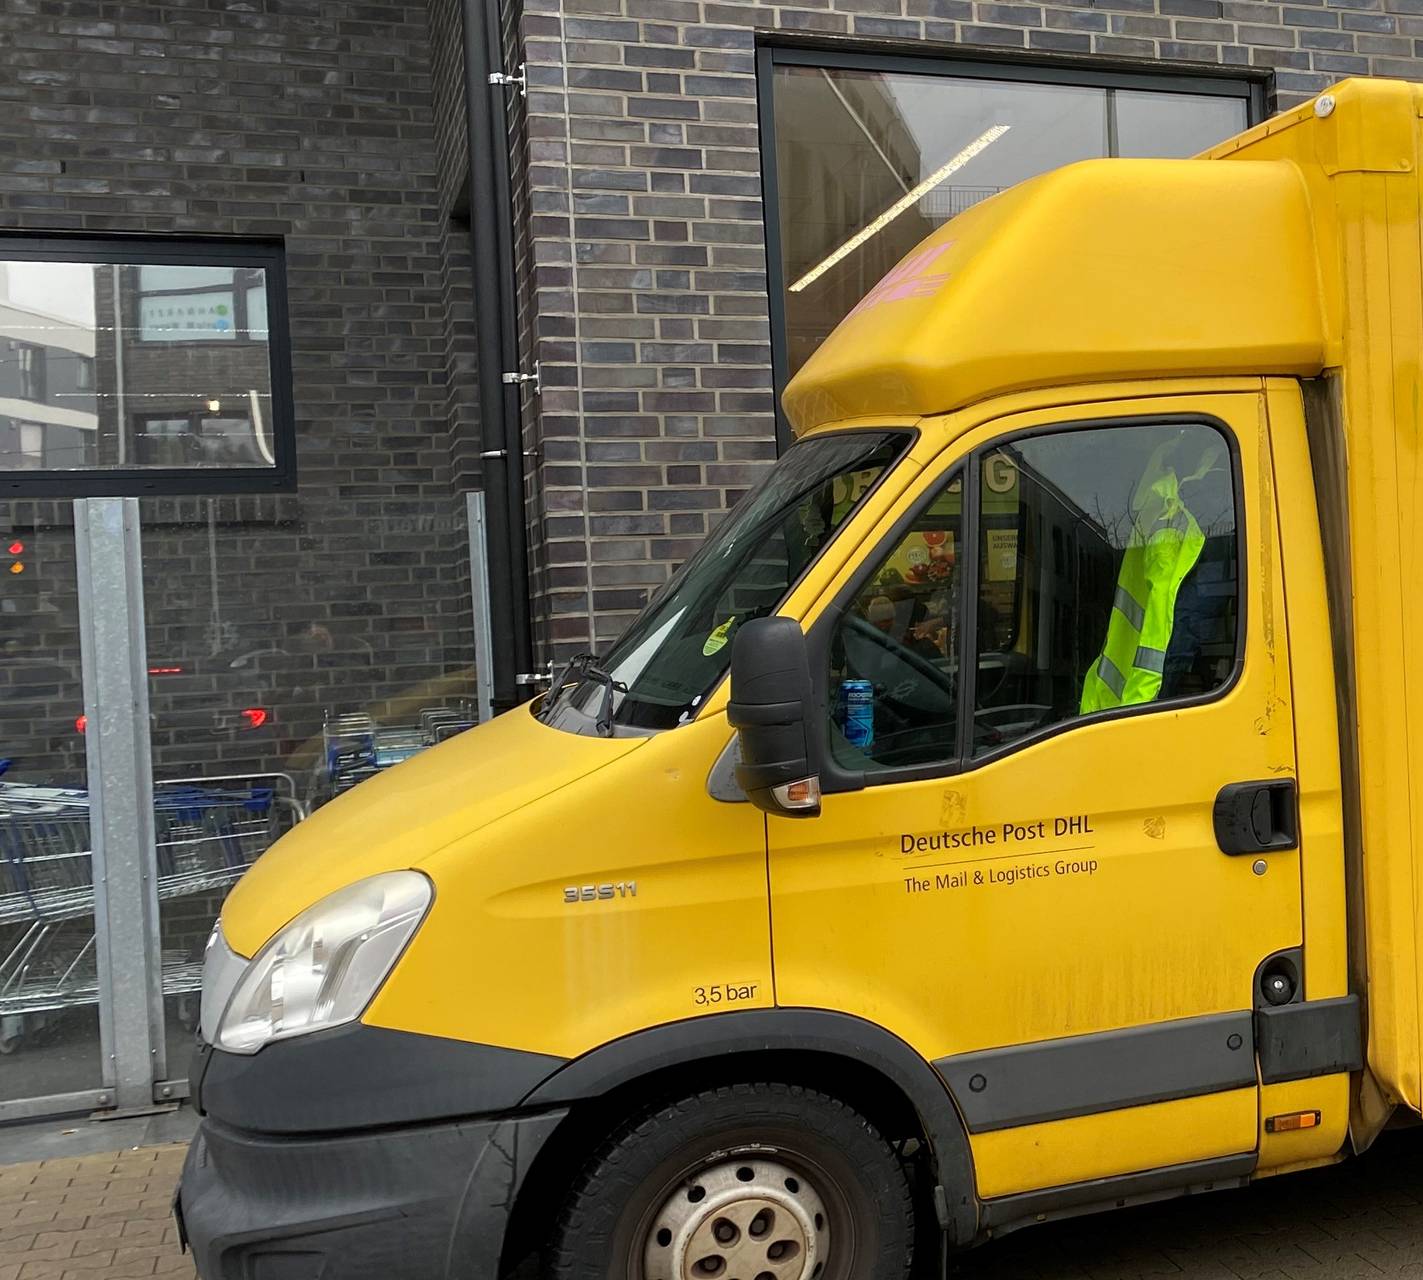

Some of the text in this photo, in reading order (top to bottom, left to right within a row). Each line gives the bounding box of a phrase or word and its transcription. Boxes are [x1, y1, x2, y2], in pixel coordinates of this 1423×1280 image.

[901, 815, 1094, 854] Deutsche Post DHL
[904, 859, 1098, 893] The Mail & Logistics Group
[564, 880, 637, 903] 35S11
[694, 984, 758, 1007] 3,5 bar
